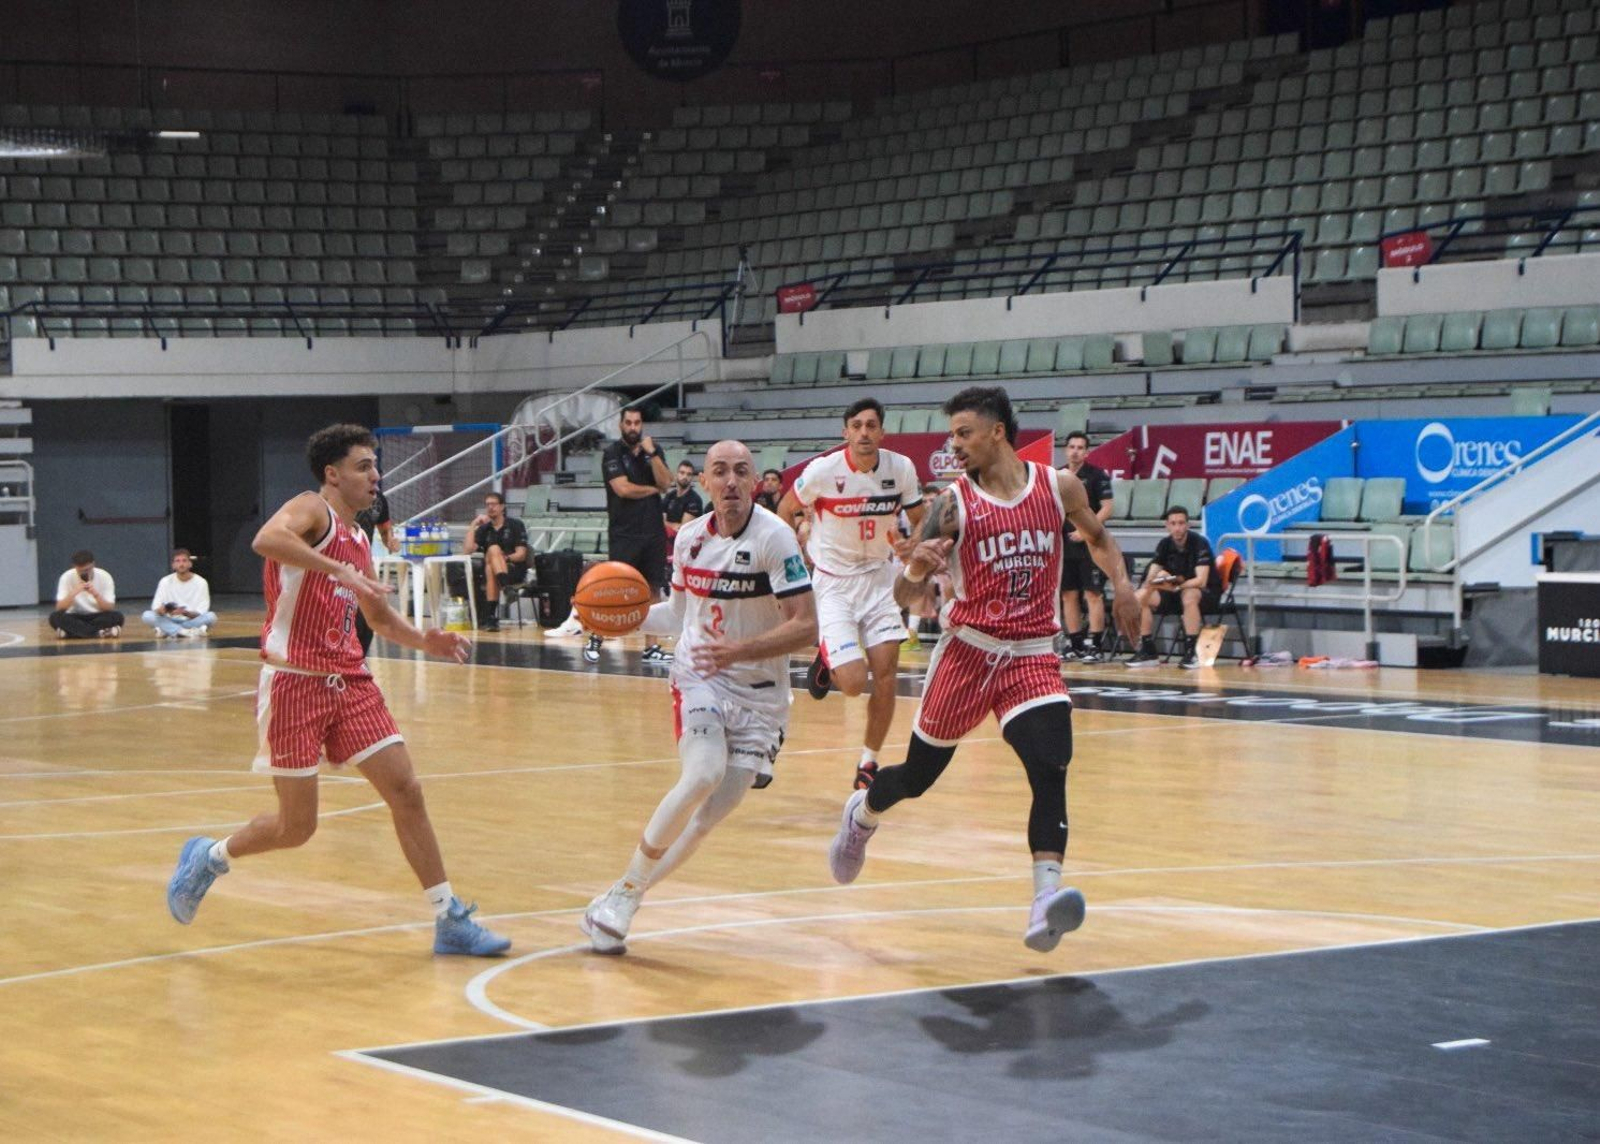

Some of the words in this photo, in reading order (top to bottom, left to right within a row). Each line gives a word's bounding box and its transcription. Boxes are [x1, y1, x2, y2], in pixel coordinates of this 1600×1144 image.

[1205, 431, 1273, 465] ENAE
[1416, 422, 1521, 484] Orenes
[1238, 476, 1323, 535] Orenes
[978, 529, 1055, 562] UCAM
[993, 555, 1046, 574] MURCIA
[1009, 570, 1032, 600] 12
[591, 609, 641, 626] Wilson
[711, 604, 725, 636] 2
